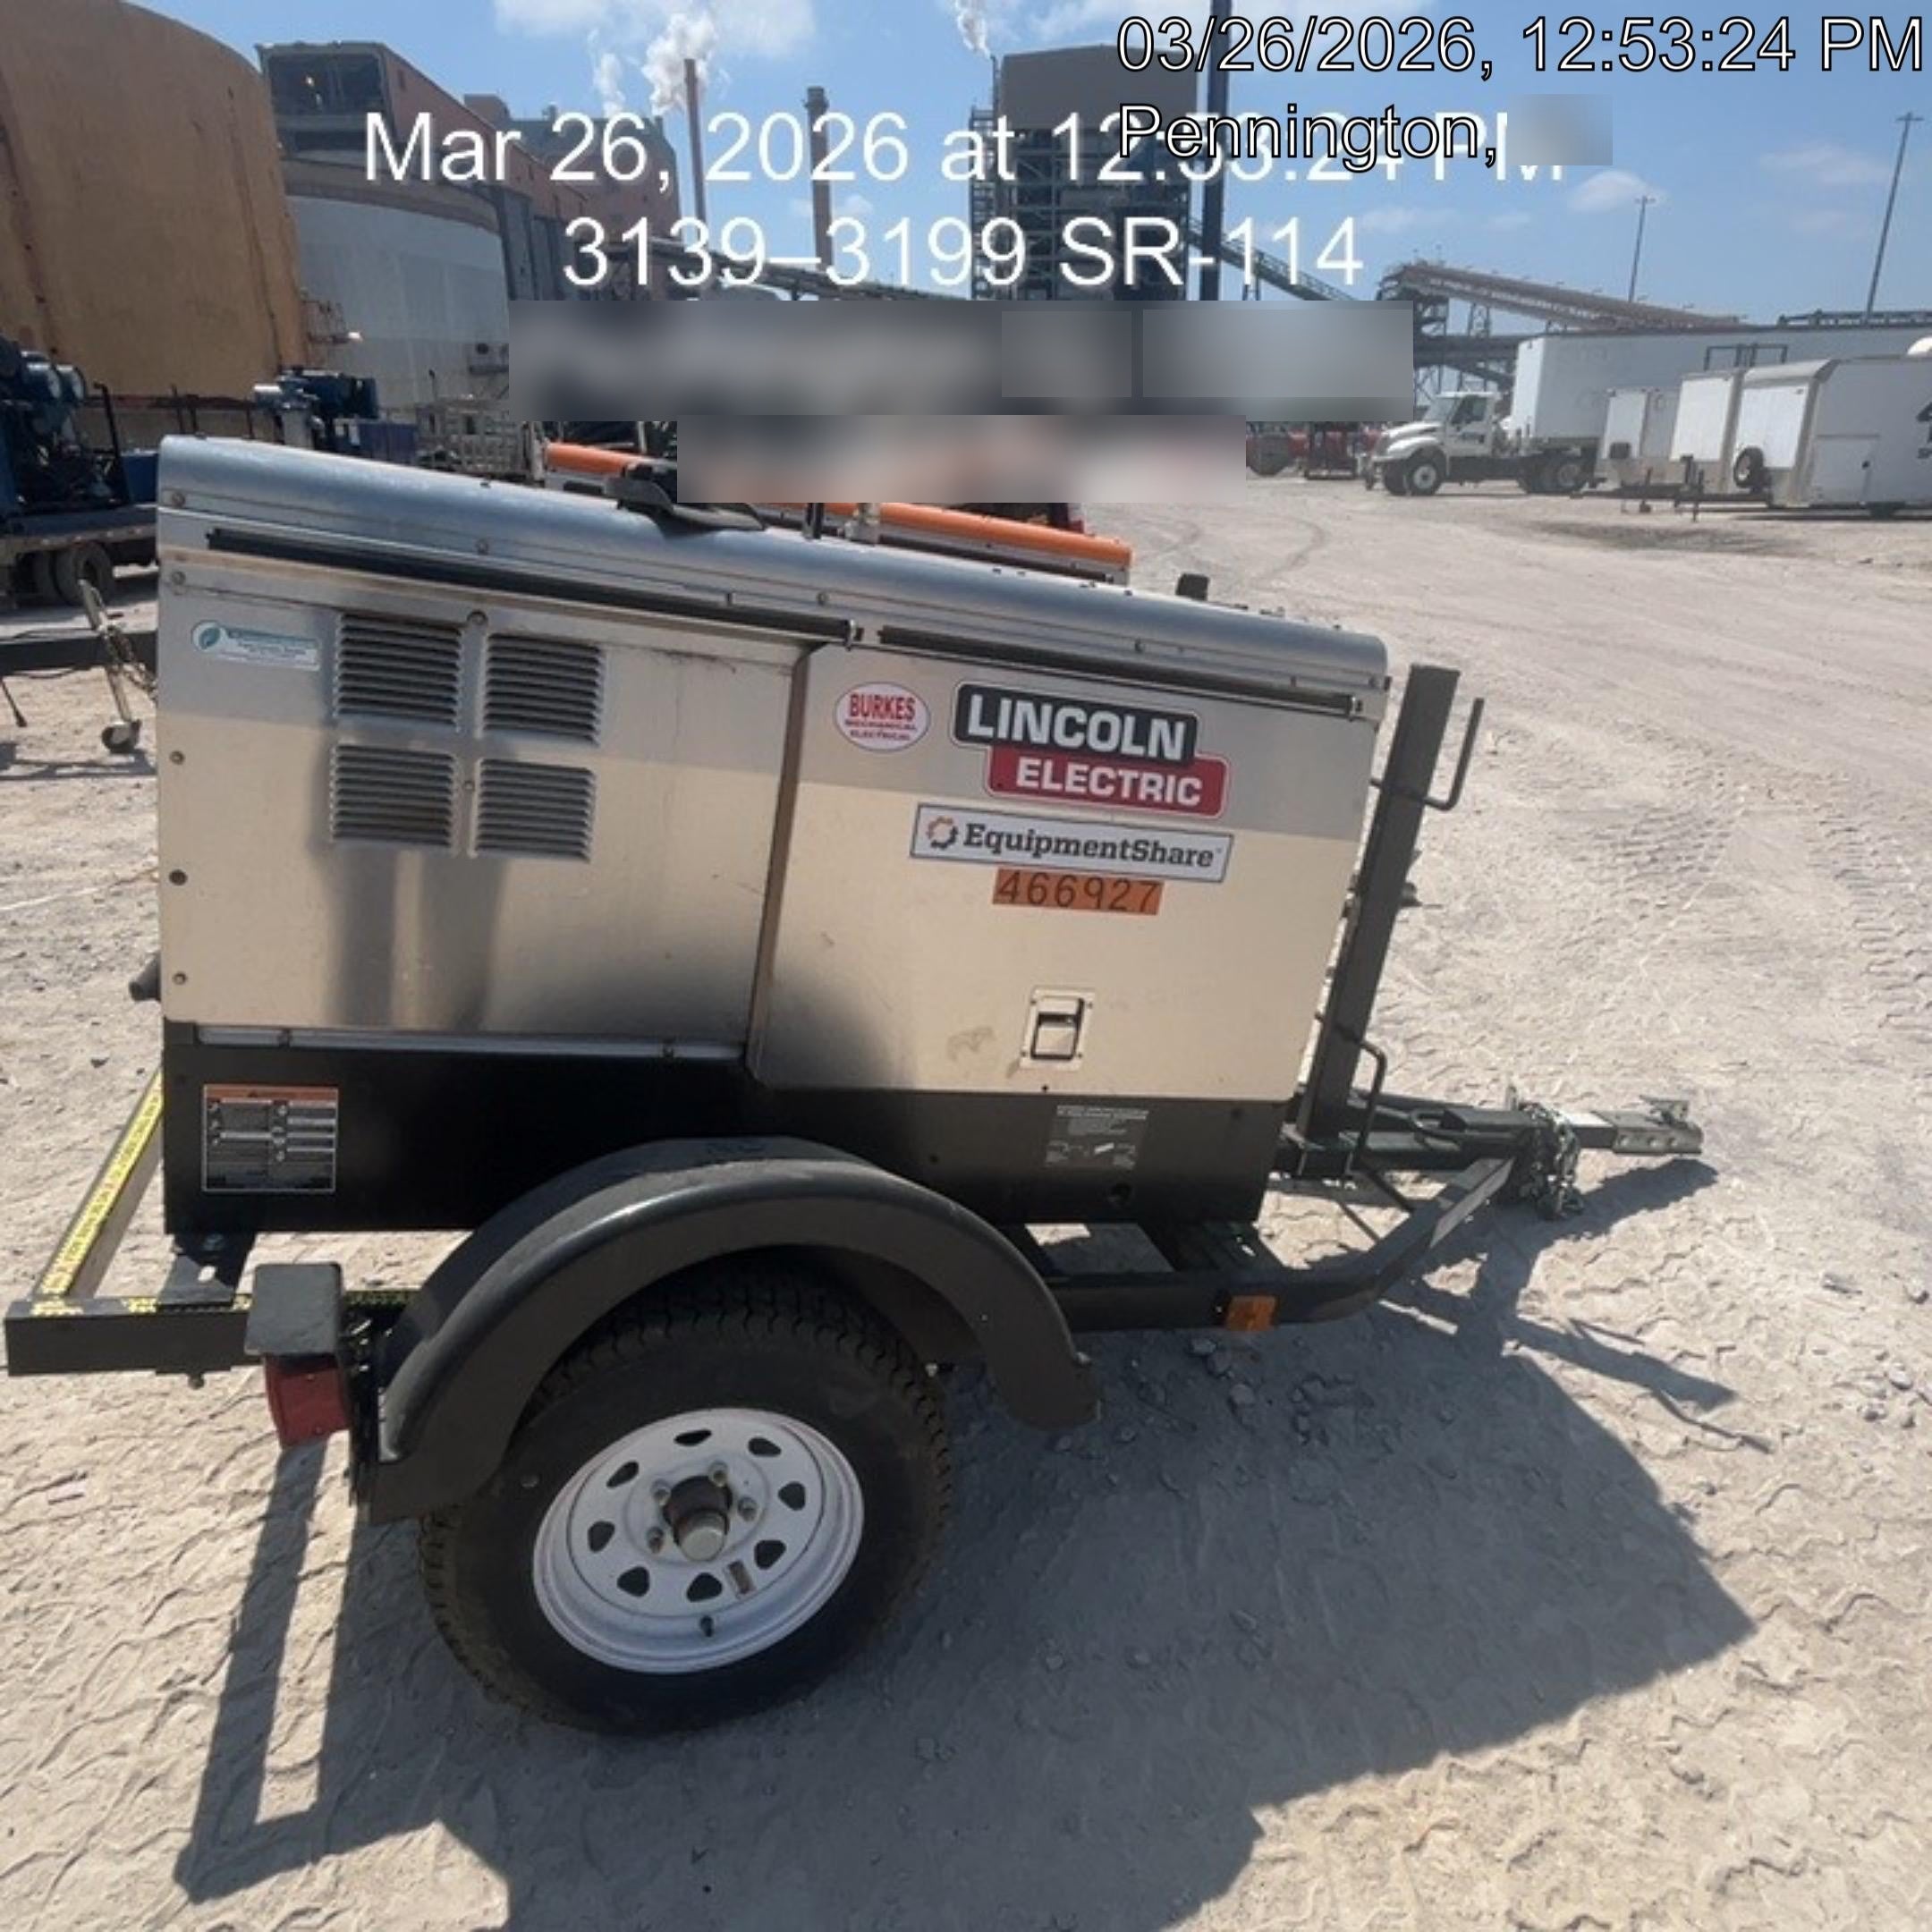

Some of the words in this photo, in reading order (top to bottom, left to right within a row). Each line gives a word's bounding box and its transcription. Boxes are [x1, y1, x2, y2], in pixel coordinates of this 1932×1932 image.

[851, 692, 916, 722] BURKES
[968, 694, 1185, 760] LINCOLN
[1015, 756, 1202, 805] ELECTRIC
[962, 822, 1216, 868] EquipmentShare
[996, 872, 1162, 914] 466927
